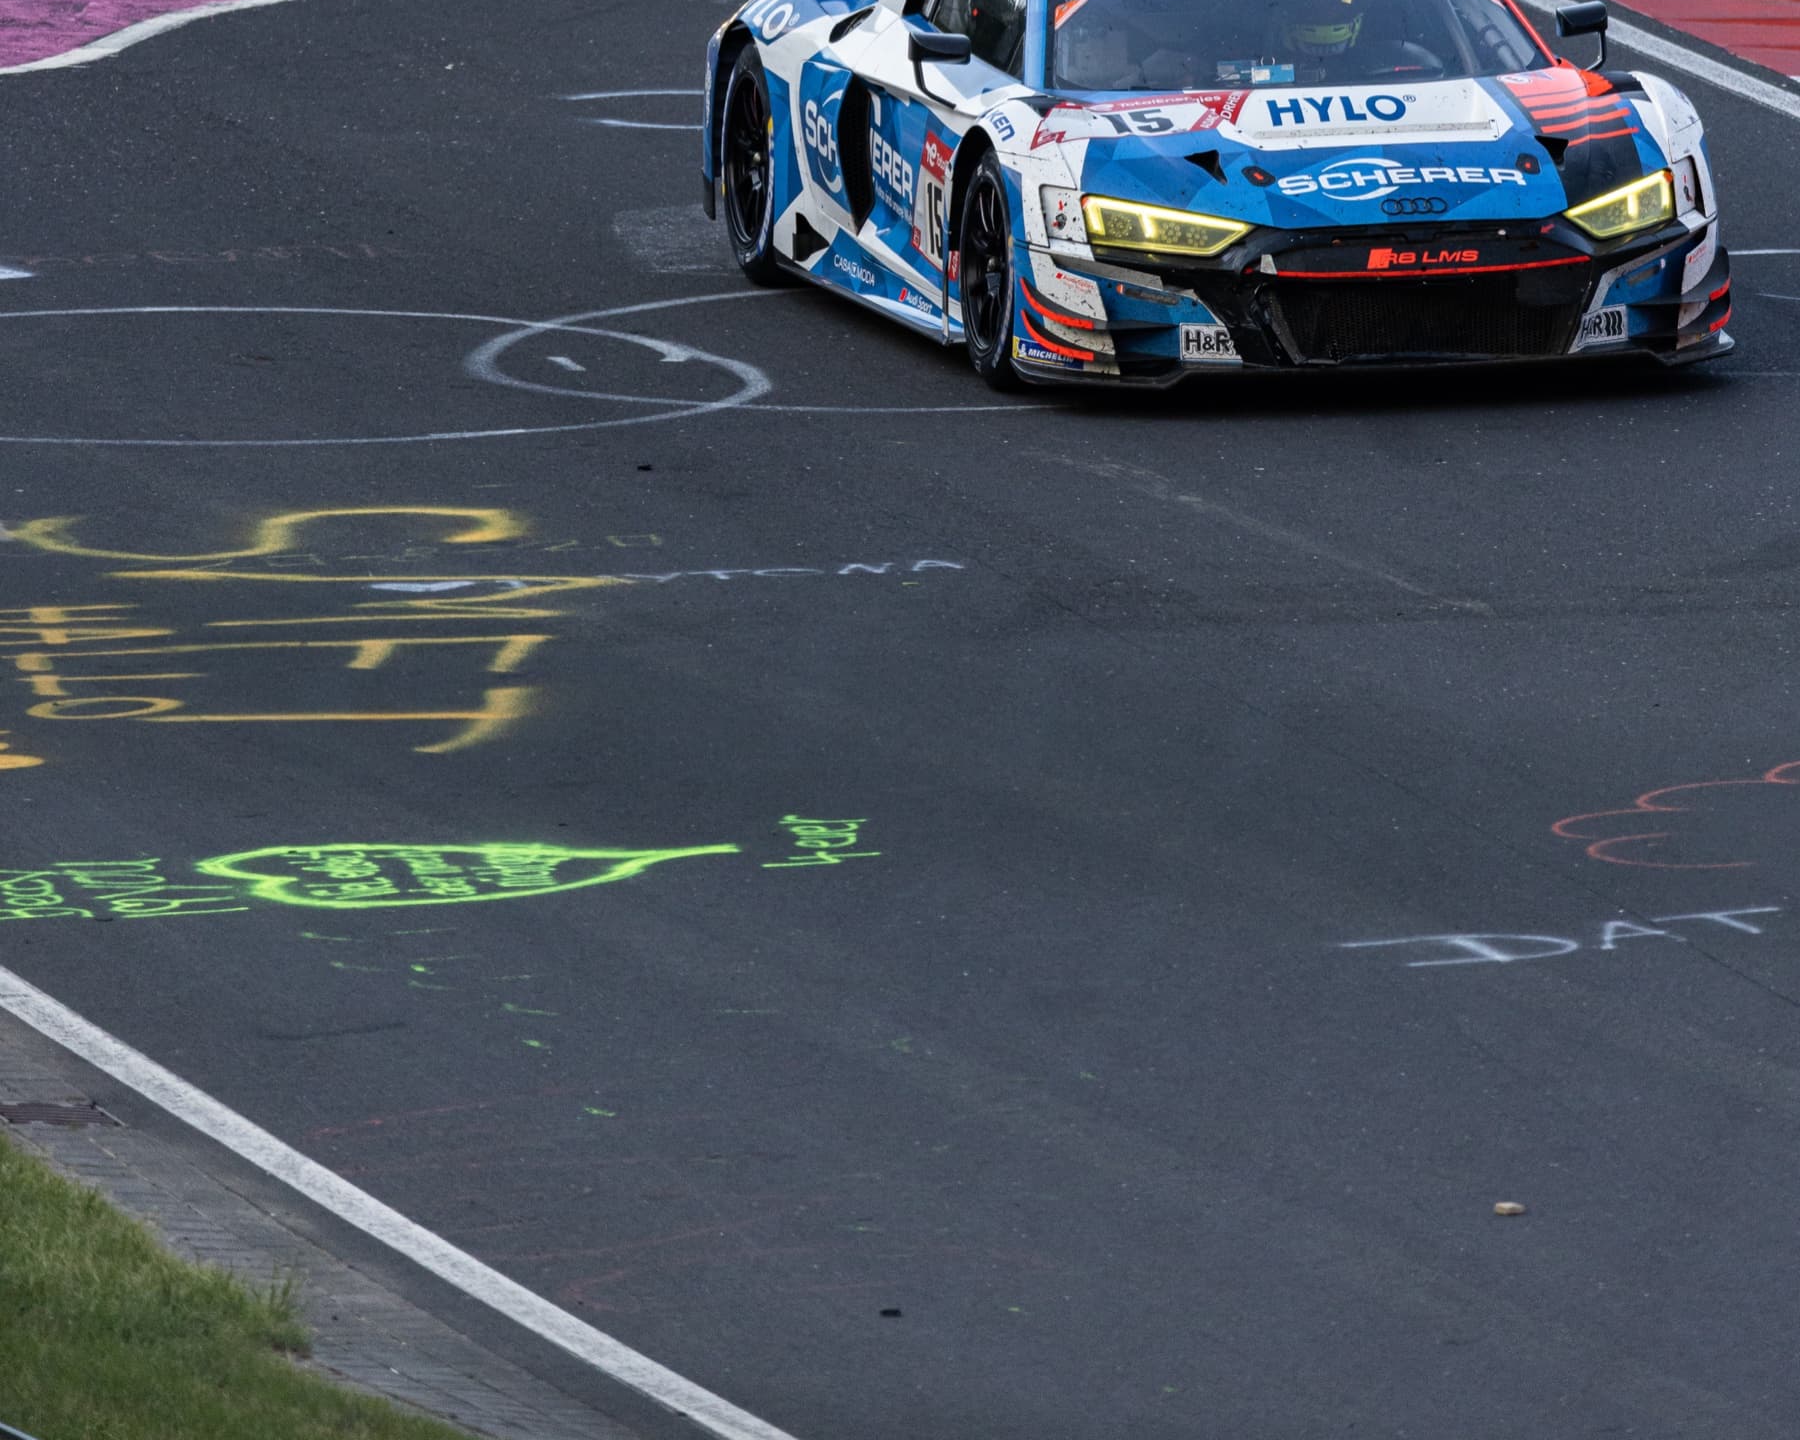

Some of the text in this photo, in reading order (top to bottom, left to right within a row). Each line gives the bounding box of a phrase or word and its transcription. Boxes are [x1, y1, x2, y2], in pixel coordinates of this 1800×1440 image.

[1101, 108, 1175, 135] 15
[1277, 165, 1528, 197] SCHERER
[927, 181, 945, 261] 15
[1422, 249, 1480, 265] LMS
